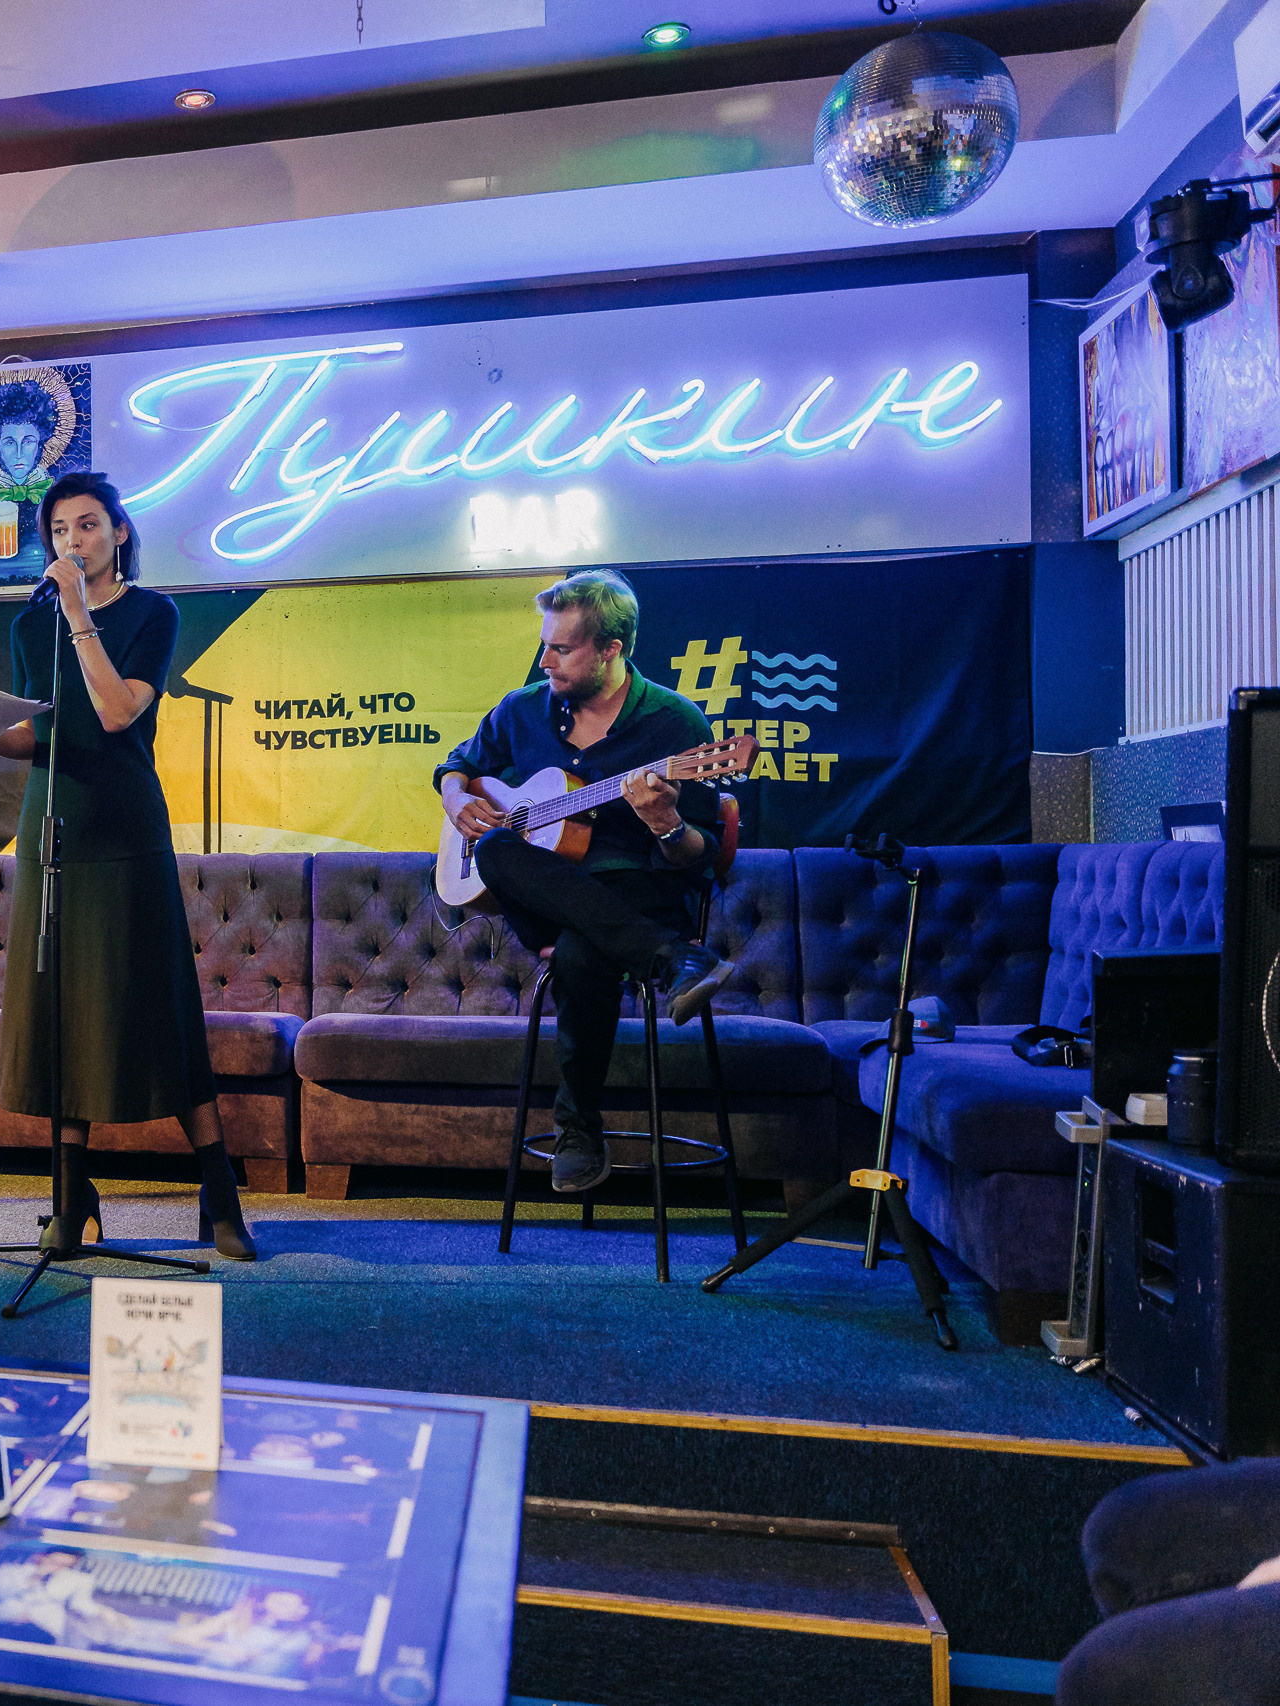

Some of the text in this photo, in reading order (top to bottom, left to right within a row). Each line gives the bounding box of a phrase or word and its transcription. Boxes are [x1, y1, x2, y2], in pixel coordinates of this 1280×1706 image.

[120, 341, 1003, 562] Пушкин
[254, 691, 416, 720] ЧИТАЙ, ЧТО
[254, 723, 441, 751] ЧУВСТВУЕШЬ
[710, 718, 811, 749] ТЕР
